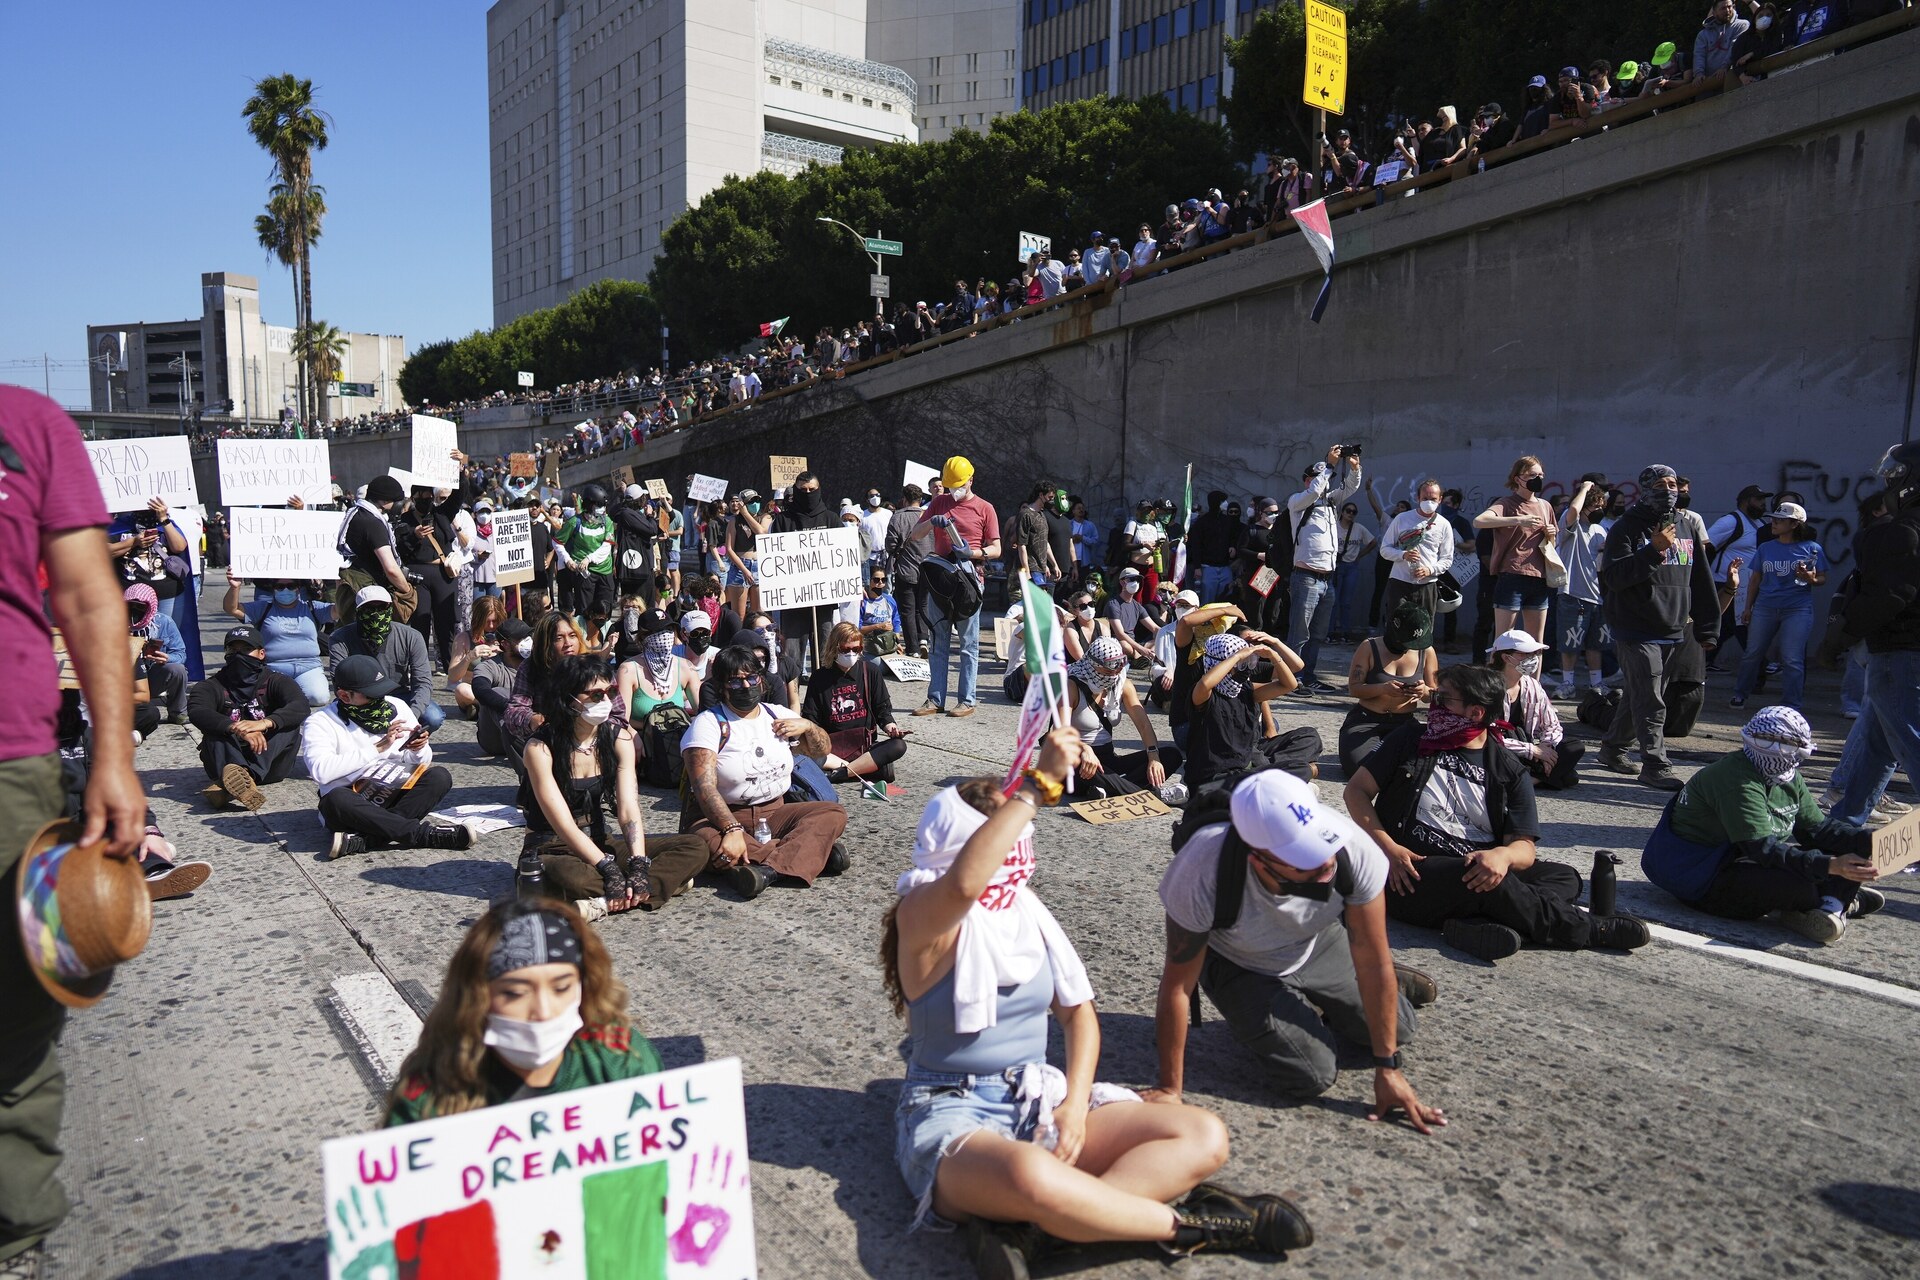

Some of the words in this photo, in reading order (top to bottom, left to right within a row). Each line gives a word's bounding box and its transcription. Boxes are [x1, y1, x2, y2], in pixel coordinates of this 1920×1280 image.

[1310, 5, 1342, 29] CAUTION
[1315, 32, 1339, 50] VERTICAL
[1311, 45, 1342, 65] CLEARANCE
[90, 444, 149, 475] PREAD
[224, 444, 266, 466] BASTA
[274, 446, 300, 464] CON
[305, 444, 322, 463] LA
[114, 474, 143, 498] NOT
[221, 468, 319, 490] DEPORTACION
[648, 480, 665, 488] FUCK
[654, 487, 666, 496] ICE
[237, 516, 286, 534] KEEP
[495, 513, 529, 525] BILLIONAIRES
[497, 525, 514, 537] ARE
[515, 522, 529, 534] THE
[496, 536, 512, 546] REAL
[512, 533, 530, 543] ENEMY
[758, 535, 786, 553] THE
[798, 532, 834, 549] REAL
[236, 552, 328, 573] TOGETHER
[507, 548, 525, 562] NOT
[760, 550, 828, 578] CRIMINAL
[830, 548, 844, 569] IS
[846, 548, 859, 567] IN
[762, 588, 787, 608] THE
[793, 581, 828, 604] WHITE
[830, 577, 862, 599] HOUSE
[1565, 626, 1585, 648] NY
[831, 684, 858, 696] LIBRE
[1080, 799, 1123, 813] ICE
[1124, 791, 1155, 806] OUT
[1101, 811, 1121, 820] OF
[1126, 805, 1161, 816] LA
[1287, 802, 1314, 826] LA
[1878, 826, 1914, 869] ABOLISH
[357, 1137, 434, 1185] WE
[487, 1105, 582, 1154] ARE
[627, 1079, 709, 1120] ALL
[461, 1117, 690, 1199] DREAMERS
